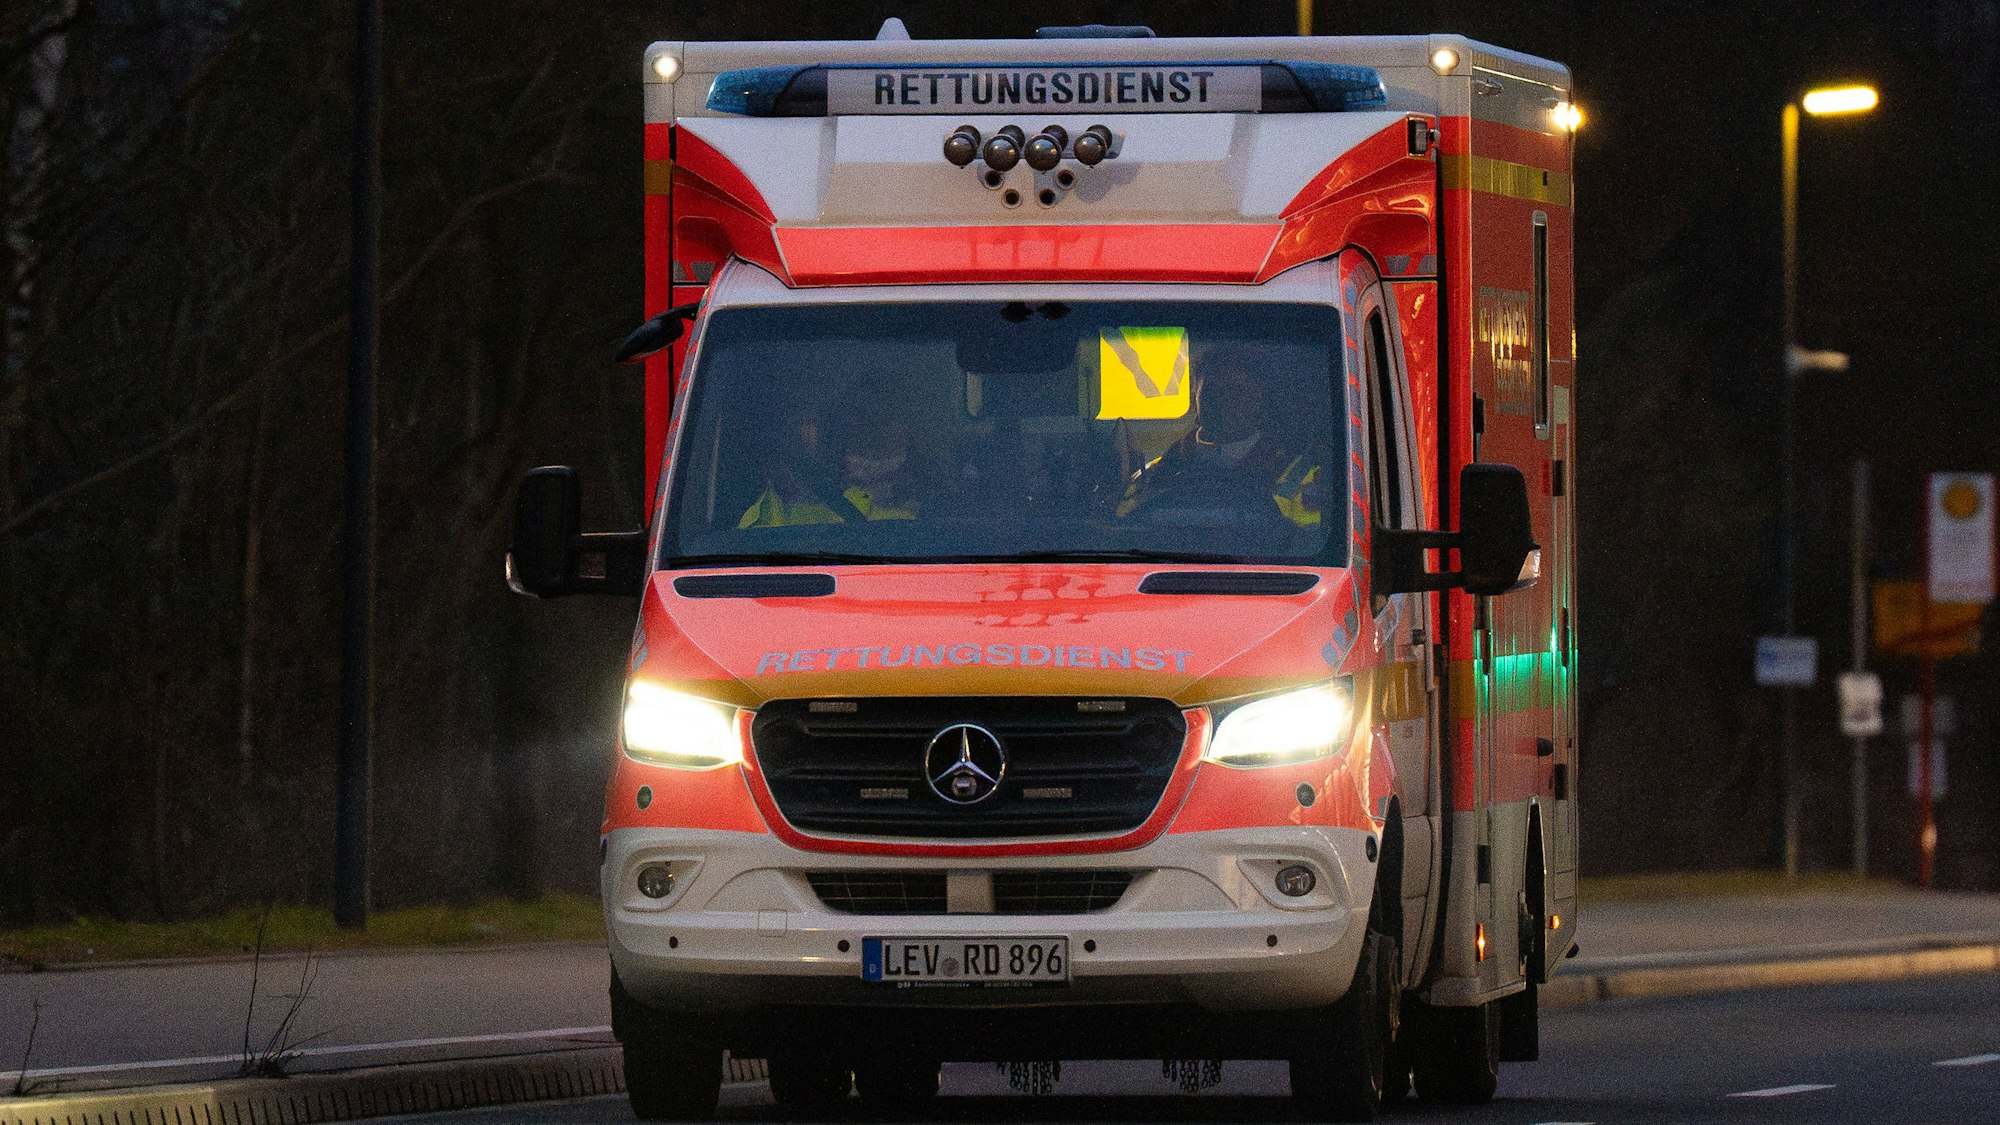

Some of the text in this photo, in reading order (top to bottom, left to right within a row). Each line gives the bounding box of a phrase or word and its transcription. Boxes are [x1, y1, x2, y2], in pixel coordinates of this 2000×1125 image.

[874, 71, 1213, 104] RETTUNGSDIENST
[756, 643, 1194, 674] RETTUNGSDIENST
[885, 944, 939, 975] LEV
[964, 944, 999, 975] RD
[1010, 944, 1062, 974] 896
